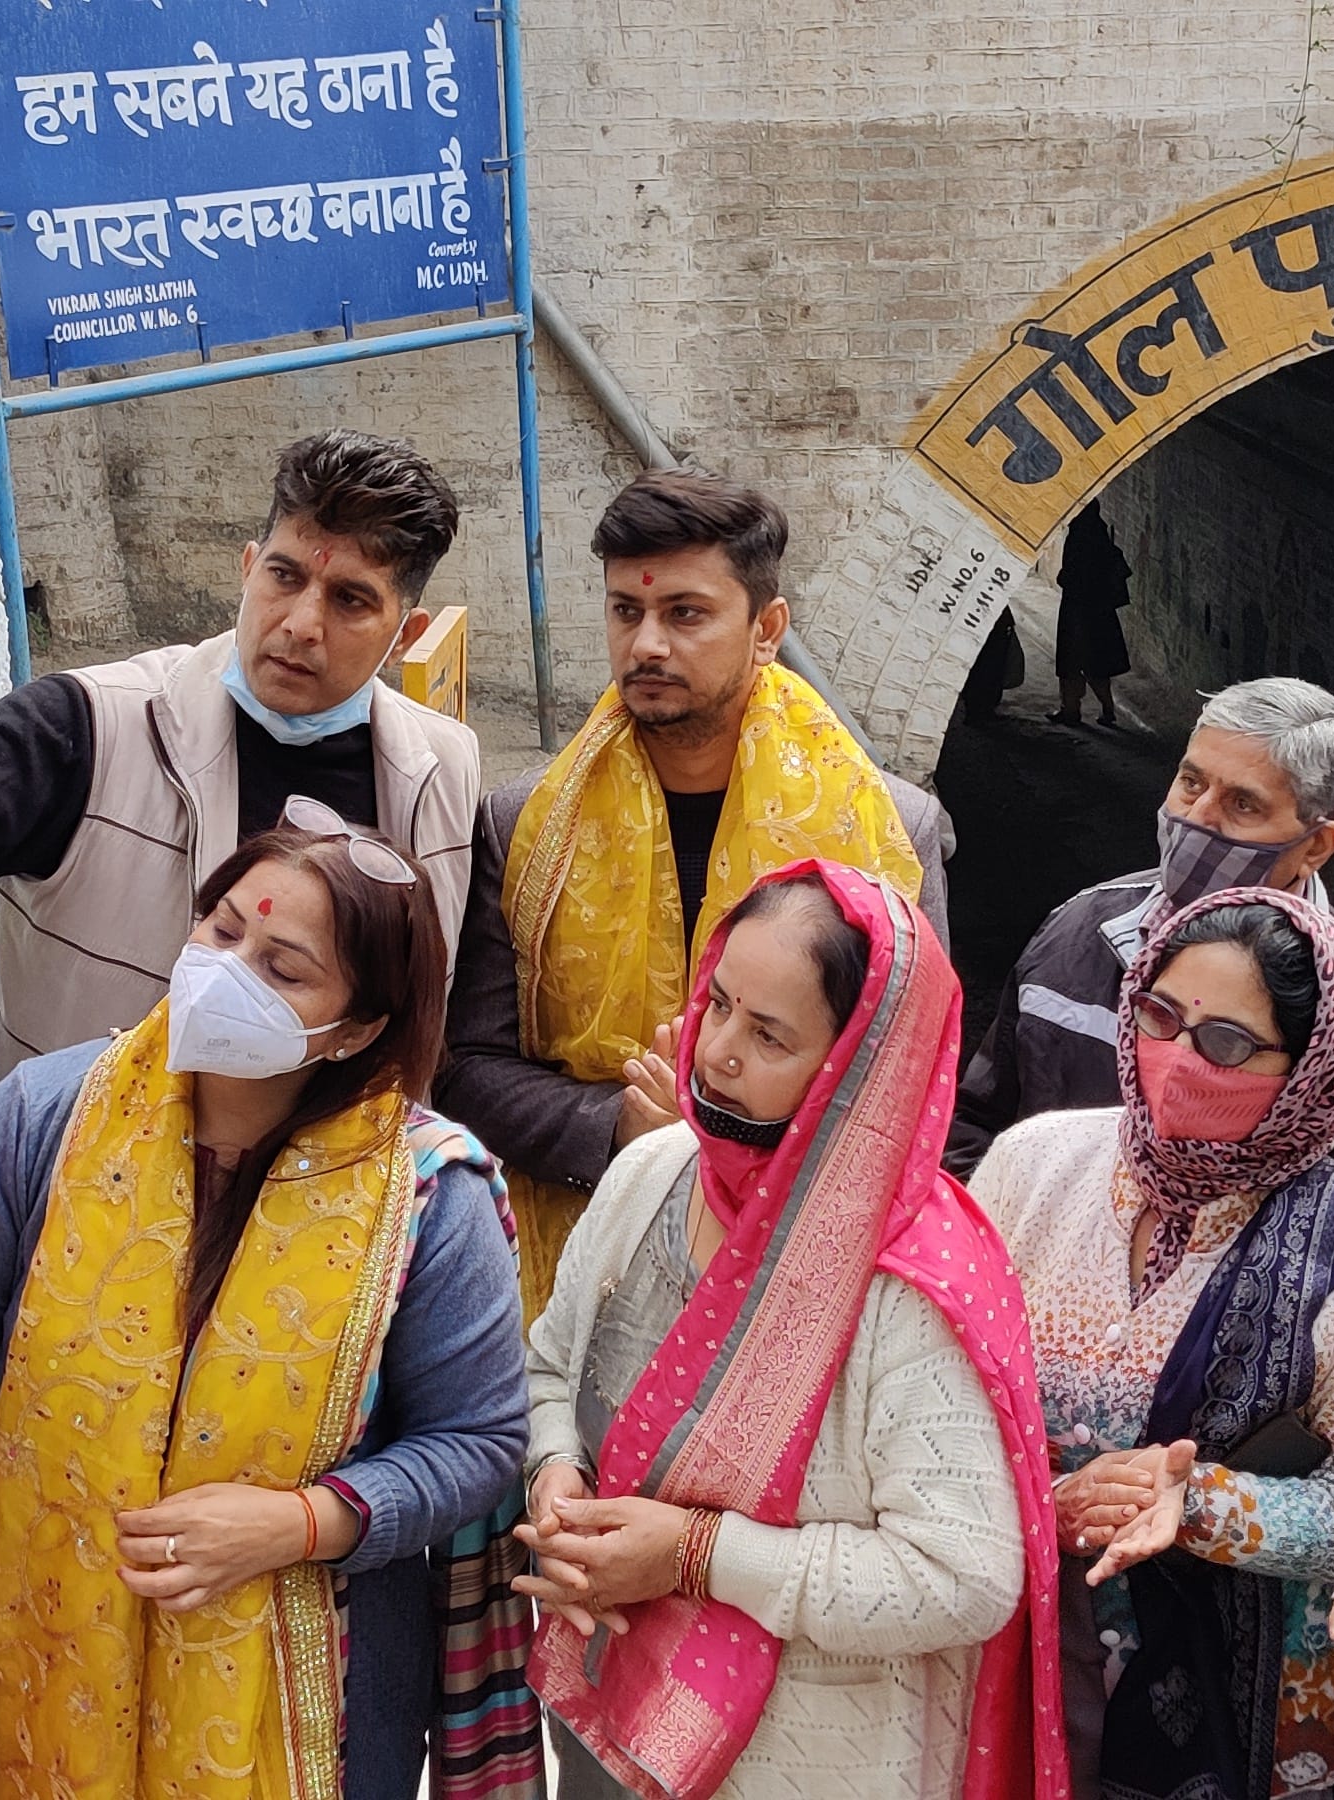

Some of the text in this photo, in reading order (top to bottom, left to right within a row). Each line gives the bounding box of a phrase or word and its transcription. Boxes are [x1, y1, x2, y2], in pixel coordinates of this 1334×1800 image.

[16, 18, 458, 144] हम सबने यह ठाना है
[27, 137, 471, 269] भारत स्वच्छ बनाना है
[48, 279, 198, 316] VIKRAM SINGH SLATHIA
[53, 316, 137, 344] COUNCILLOR
[186, 304, 198, 323] 6
[965, 252, 1228, 484] गोल
